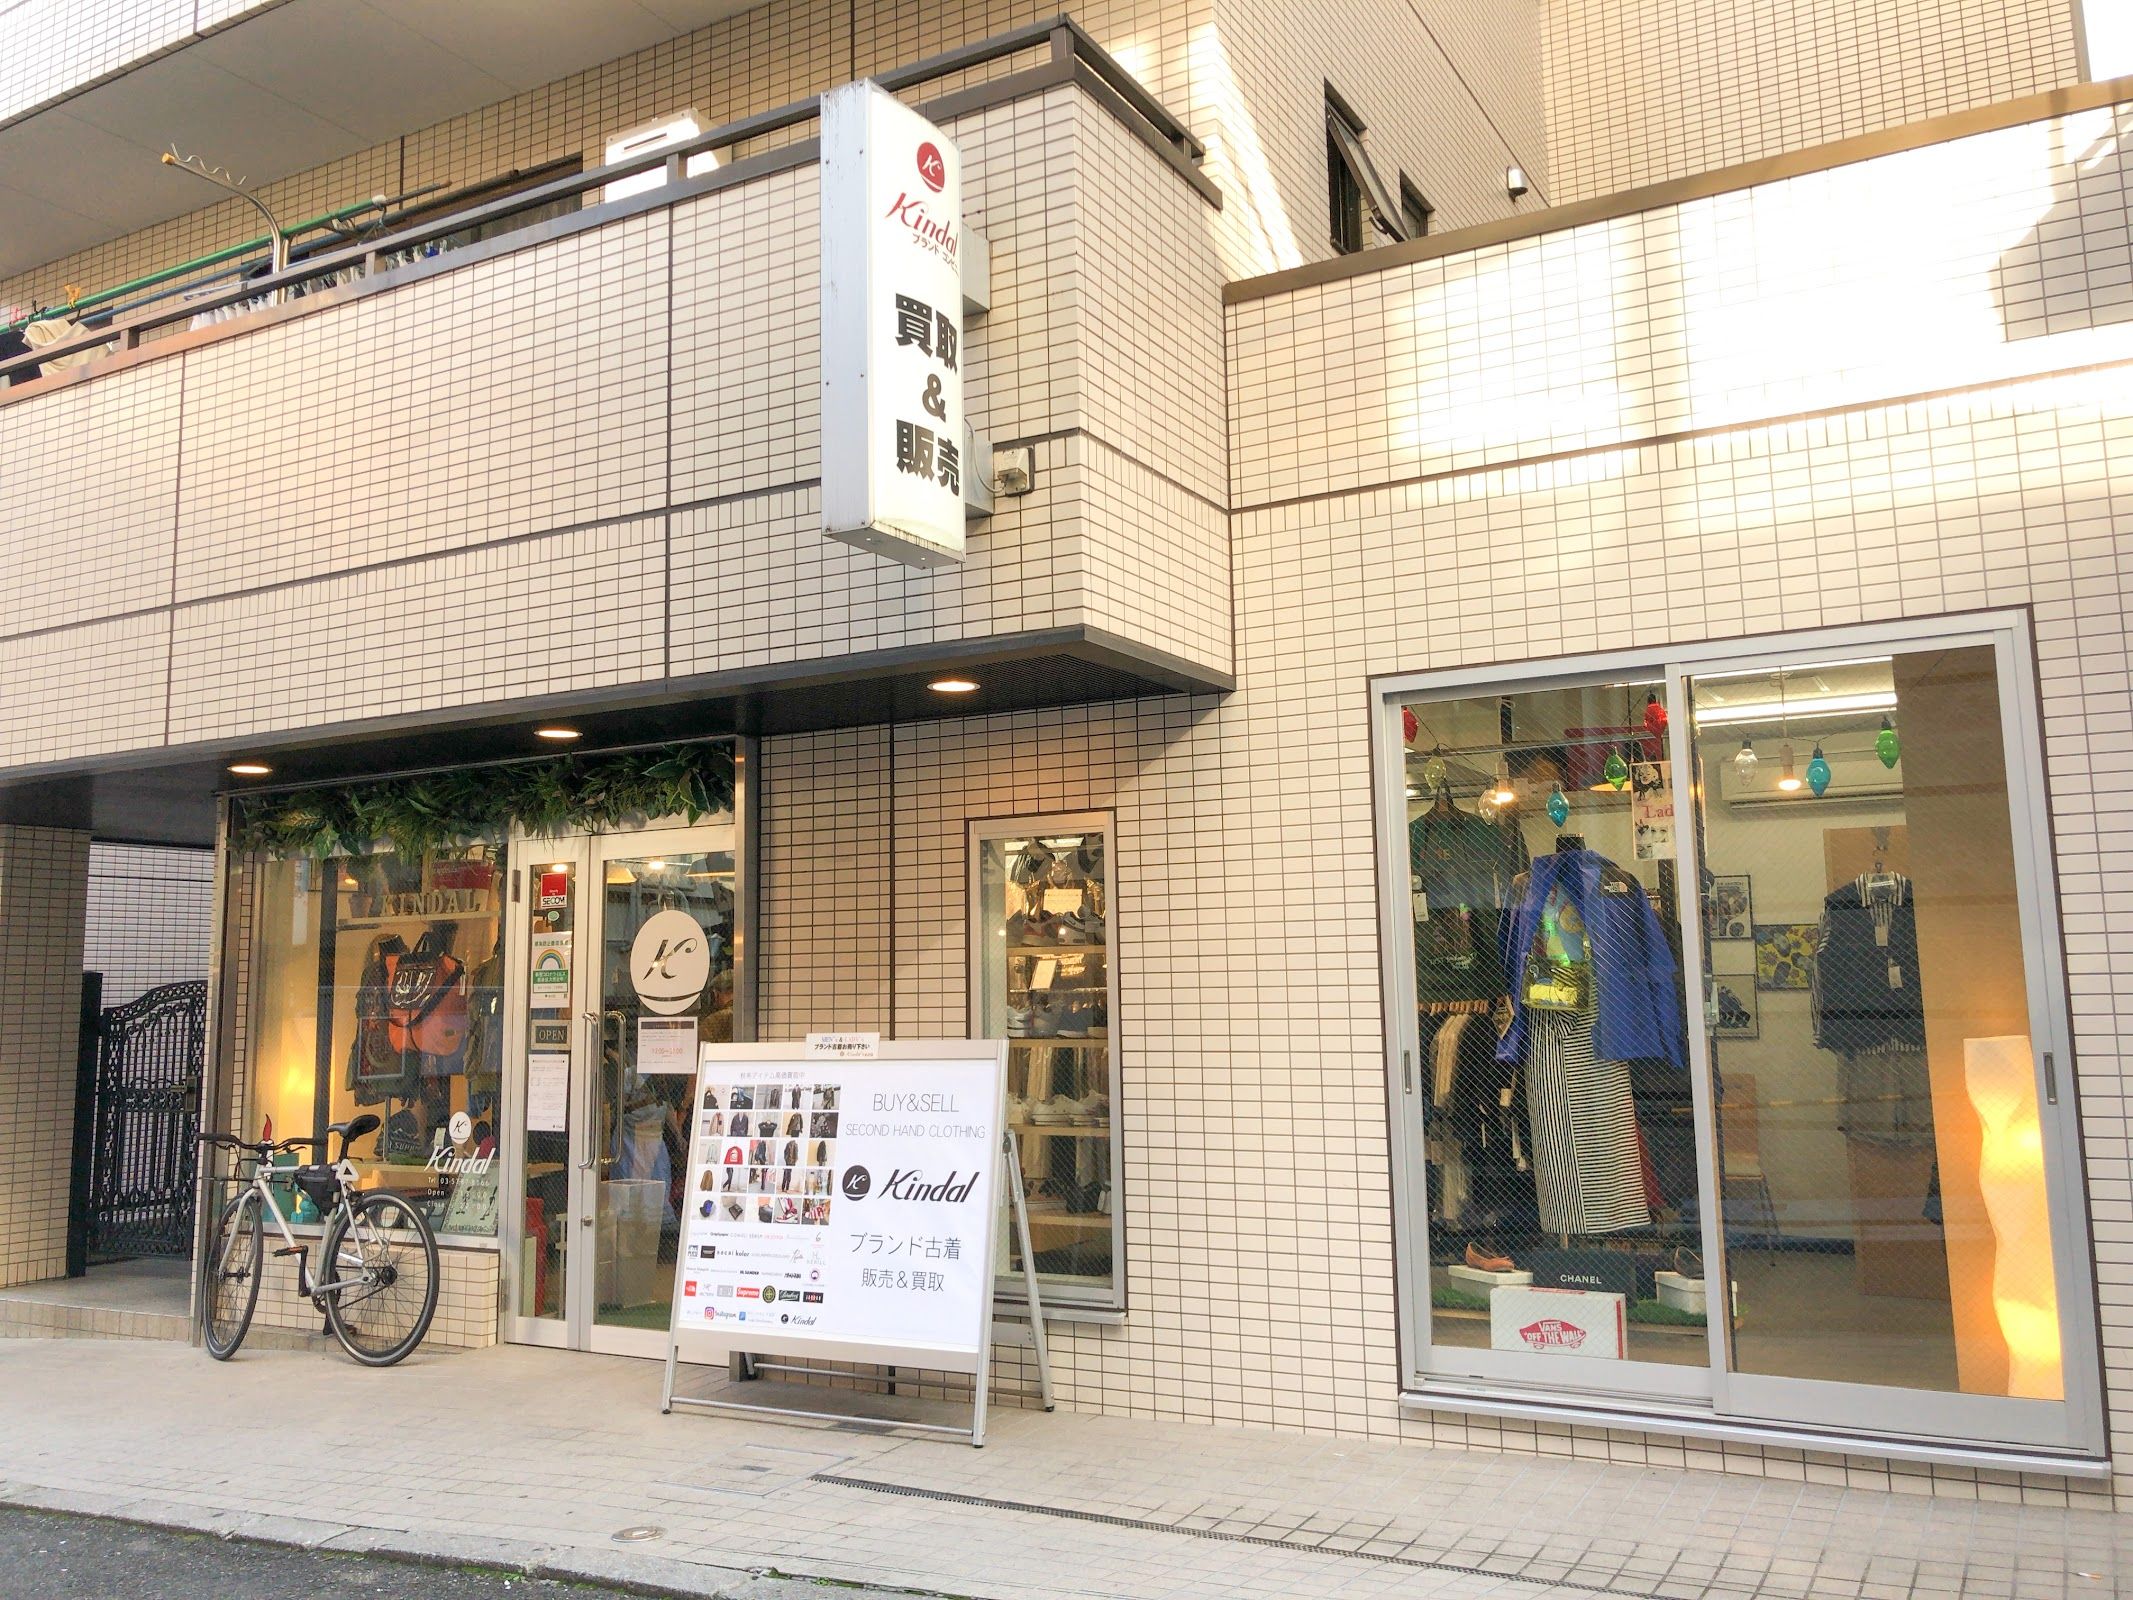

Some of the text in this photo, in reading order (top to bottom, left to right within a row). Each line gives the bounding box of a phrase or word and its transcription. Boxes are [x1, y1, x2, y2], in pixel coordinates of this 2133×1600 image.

[884, 192, 959, 257] Kindal
[895, 293, 958, 375] 買取
[922, 373, 946, 423] &
[896, 418, 960, 497] 販売
[380, 888, 480, 916] KINDAL
[542, 896, 566, 905] SECOM
[539, 1029, 565, 1041] OPEN
[872, 1093, 960, 1113] BUY&SELL
[845, 1123, 986, 1139] SECOND HAND CLOTHING
[424, 1146, 496, 1175] Kindal
[427, 1188, 445, 1197] Open
[877, 1168, 981, 1203] Kindal
[427, 1200, 445, 1208] Close
[850, 1232, 962, 1260] ブランド古着
[861, 1267, 945, 1292] 販売&買取
[1560, 1274, 1602, 1284] CHANEL
[791, 1314, 818, 1326] Kindal
[1539, 1321, 1562, 1332] VANS
[1543, 1331, 1561, 1345] THE
